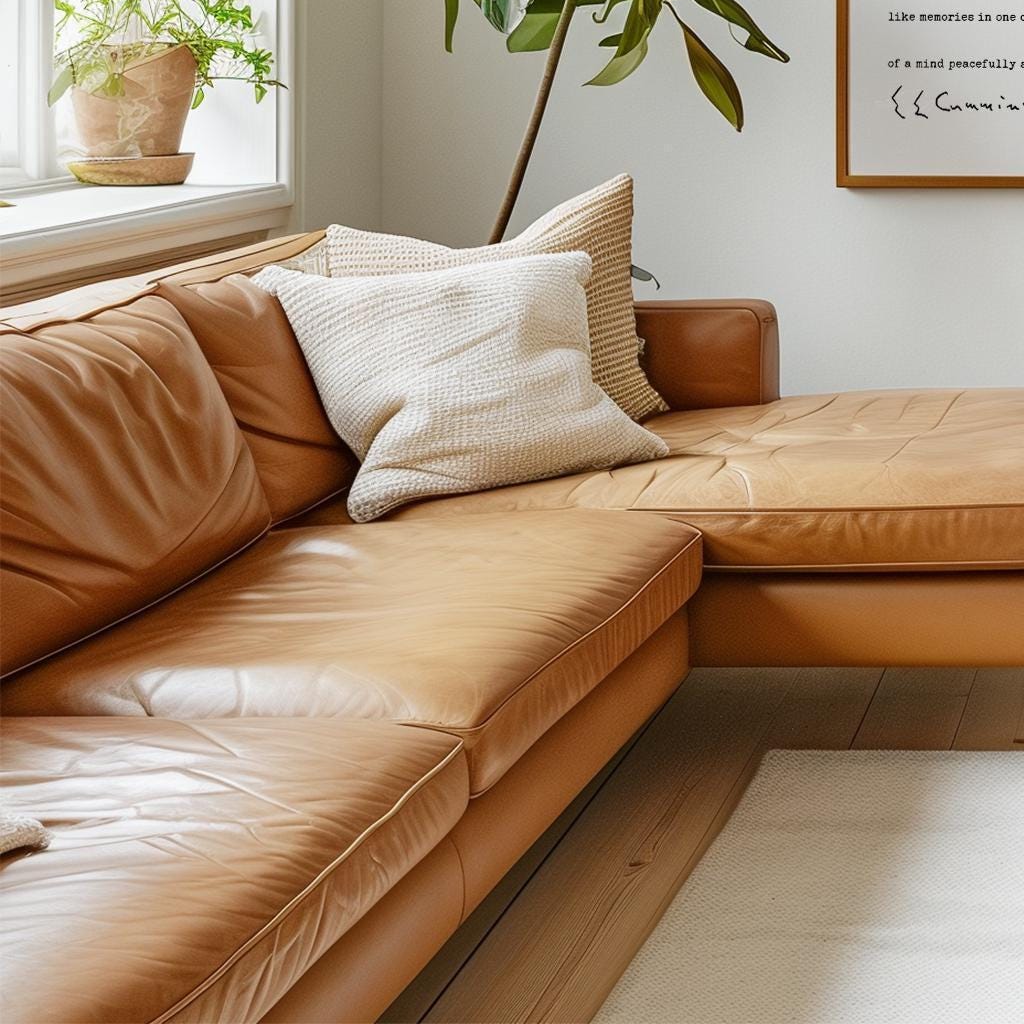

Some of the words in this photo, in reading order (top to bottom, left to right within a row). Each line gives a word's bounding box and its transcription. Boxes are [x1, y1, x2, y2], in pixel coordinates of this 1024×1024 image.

[888, 11, 916, 22] like
[919, 12, 975, 22] memories
[977, 12, 993, 22] in
[995, 14, 1017, 22] one
[887, 58, 901, 69] of
[904, 60, 912, 69] a
[915, 57, 945, 69] mind
[948, 58, 1017, 71] peacefully
